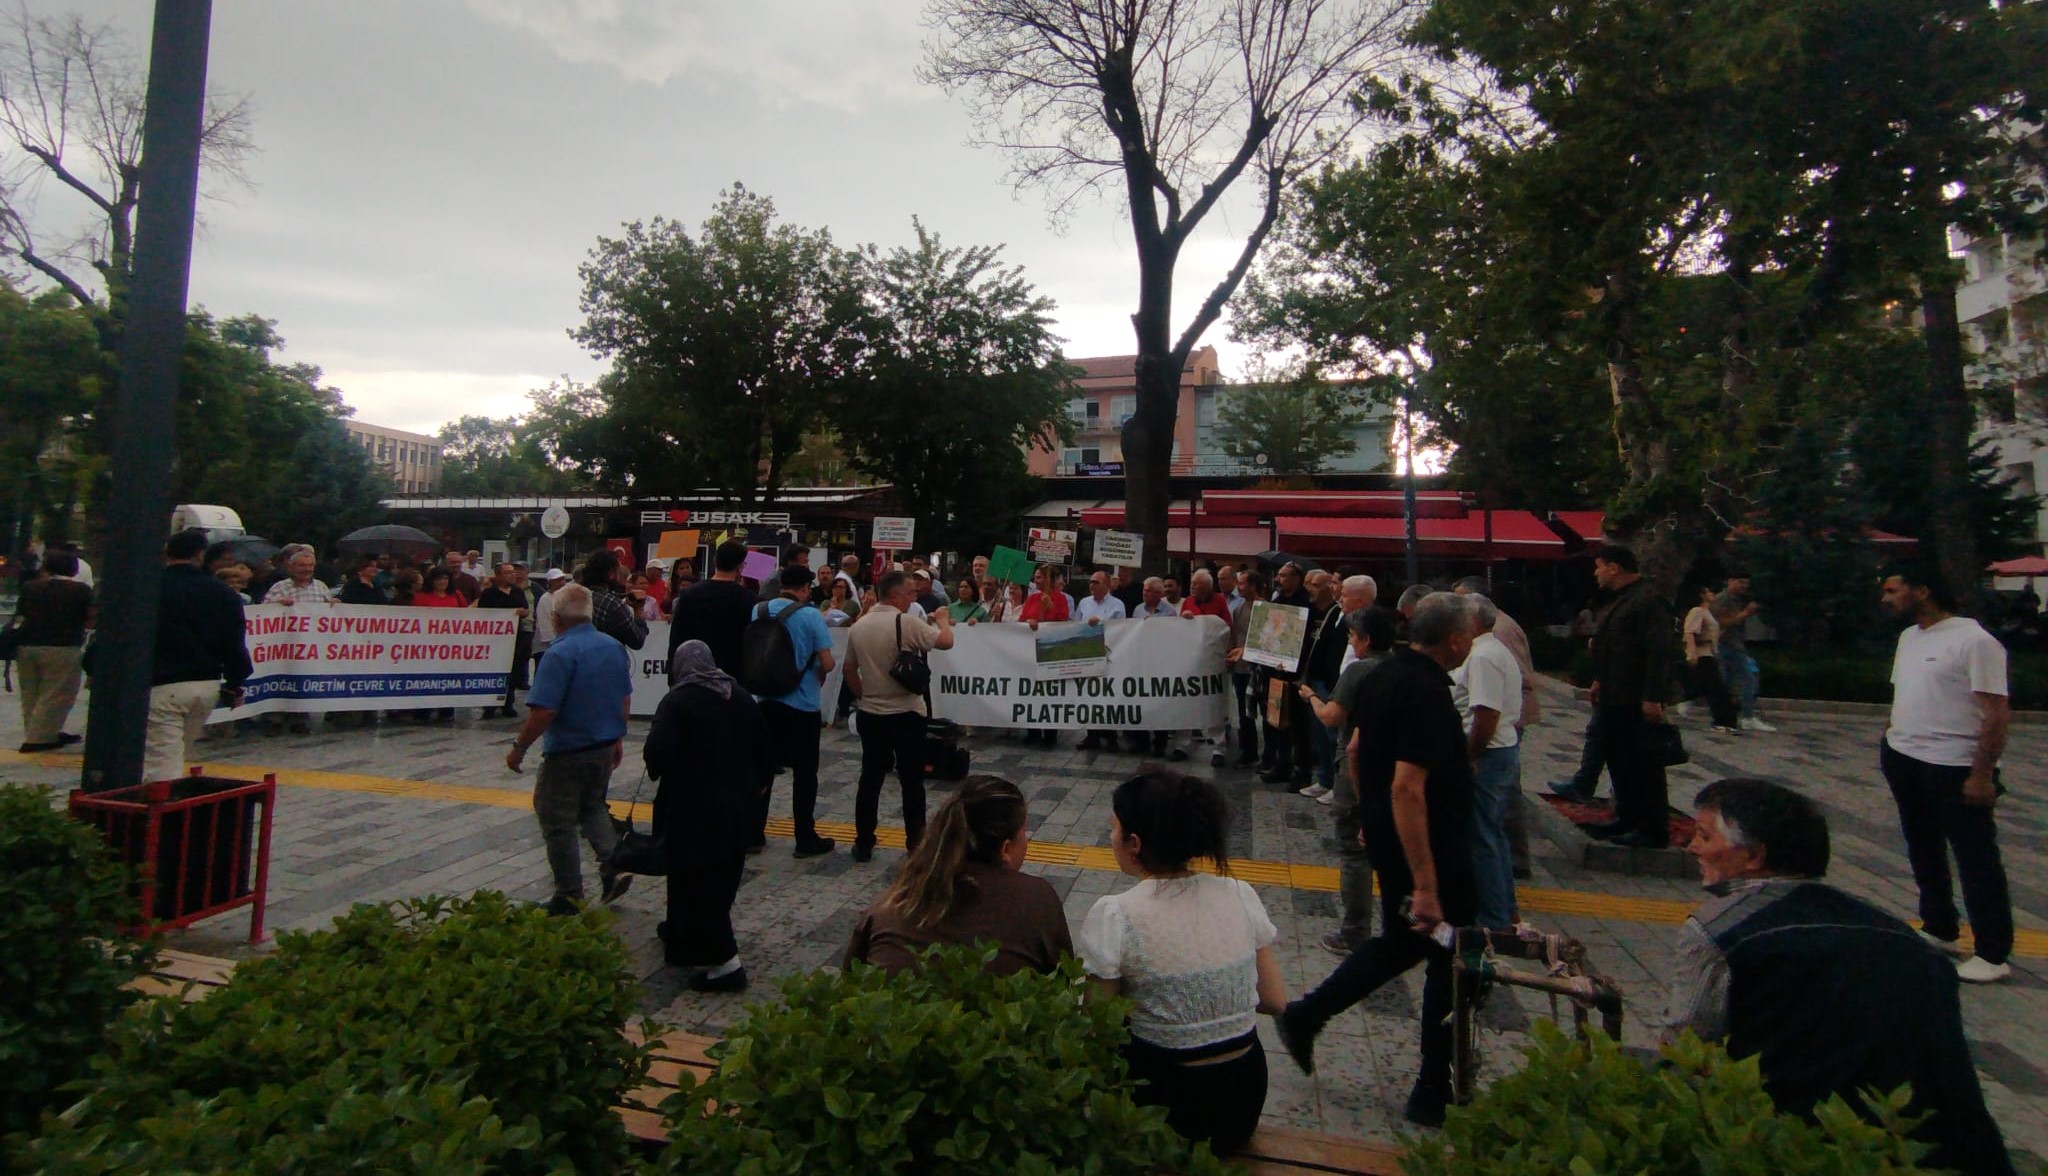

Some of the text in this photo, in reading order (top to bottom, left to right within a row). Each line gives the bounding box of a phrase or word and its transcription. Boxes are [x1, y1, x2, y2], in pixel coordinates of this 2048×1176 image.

[317, 616, 421, 634] SUYUMUZA
[428, 619, 515, 635] HAVAMIZA
[253, 640, 490, 664] ĞIMIZA SAHİP ÇIKIYORUZ!
[263, 679, 299, 692] DOĞAL
[303, 678, 345, 692] ÜRETİM
[349, 680, 384, 694] ÇEVRE
[388, 679, 402, 690] VE
[405, 679, 461, 691] DAYANIŞMA
[464, 676, 506, 689] DERNEĞİ
[940, 676, 1011, 696] MURAT
[1073, 676, 1115, 697] YOK
[1122, 673, 1224, 698] OLMASIN
[1012, 703, 1142, 725] PLATFORMU
